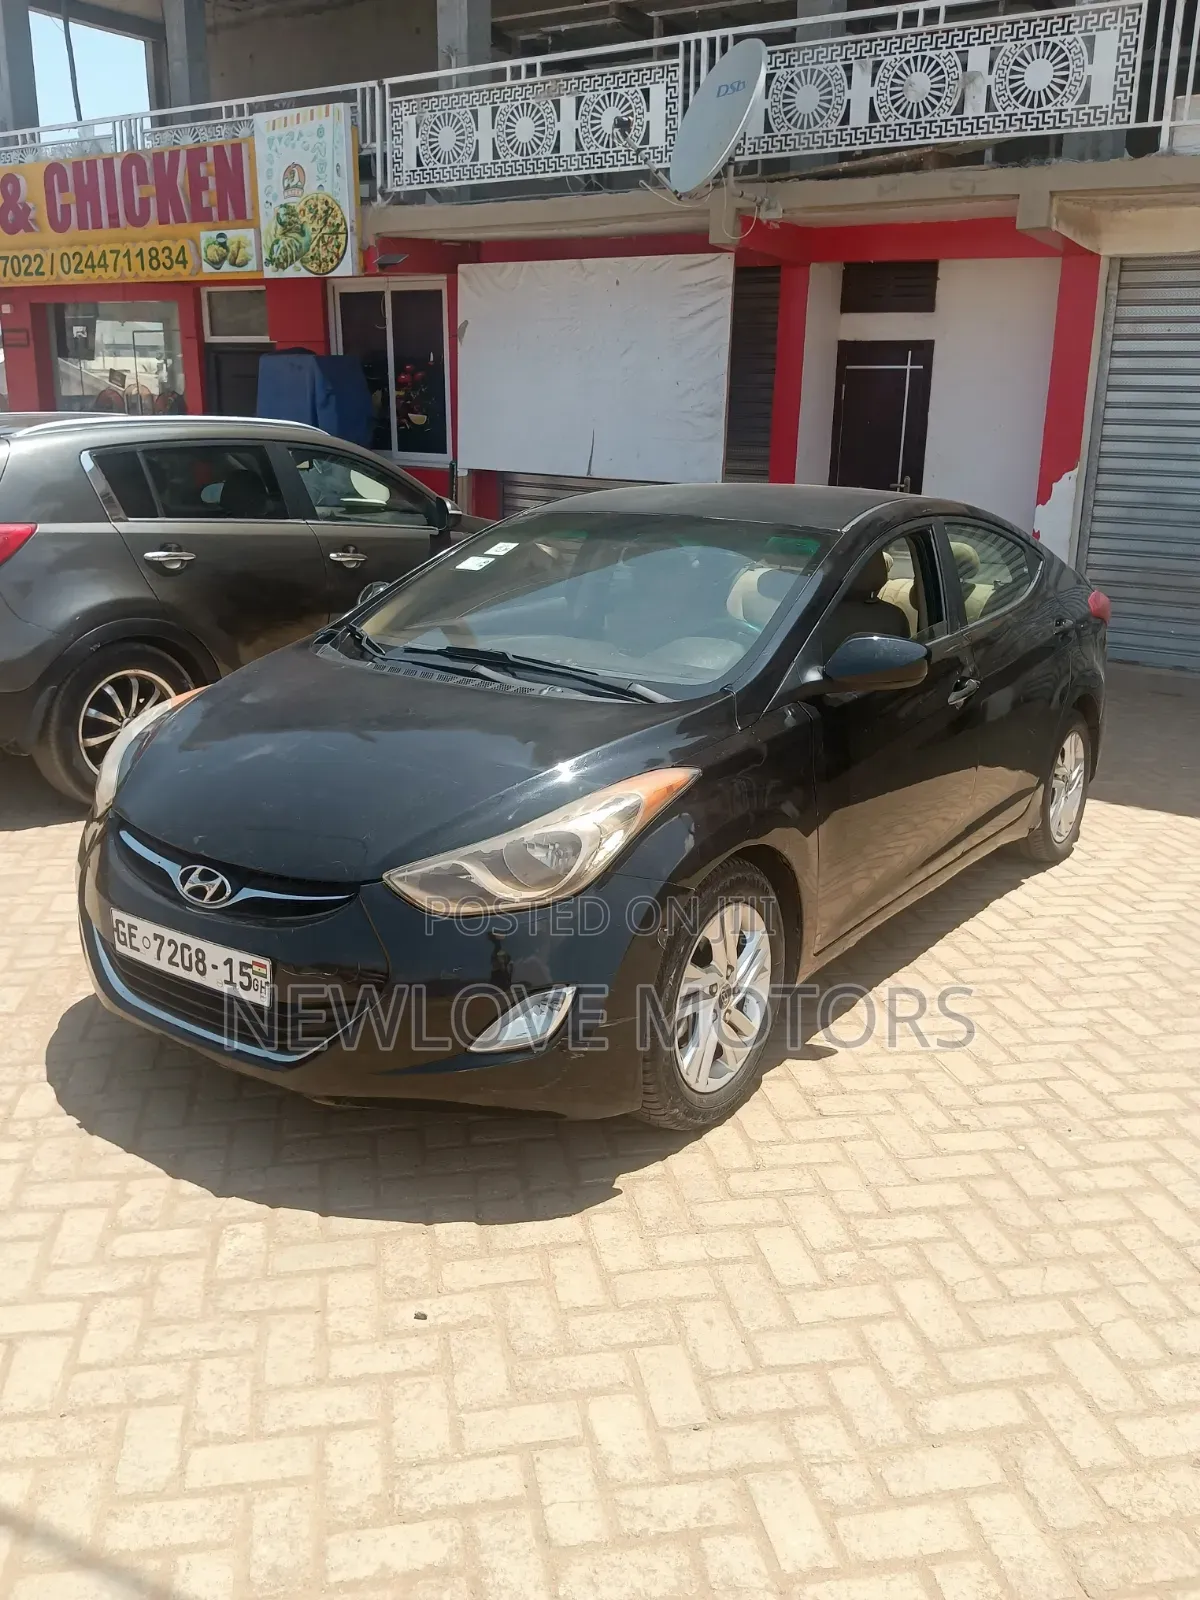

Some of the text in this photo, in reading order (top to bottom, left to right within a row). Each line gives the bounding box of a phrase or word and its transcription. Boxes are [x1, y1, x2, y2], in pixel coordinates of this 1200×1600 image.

[0, 143, 247, 235] & CHICKEN
[60, 244, 188, 275] 0244711834
[115, 919, 140, 952] GE
